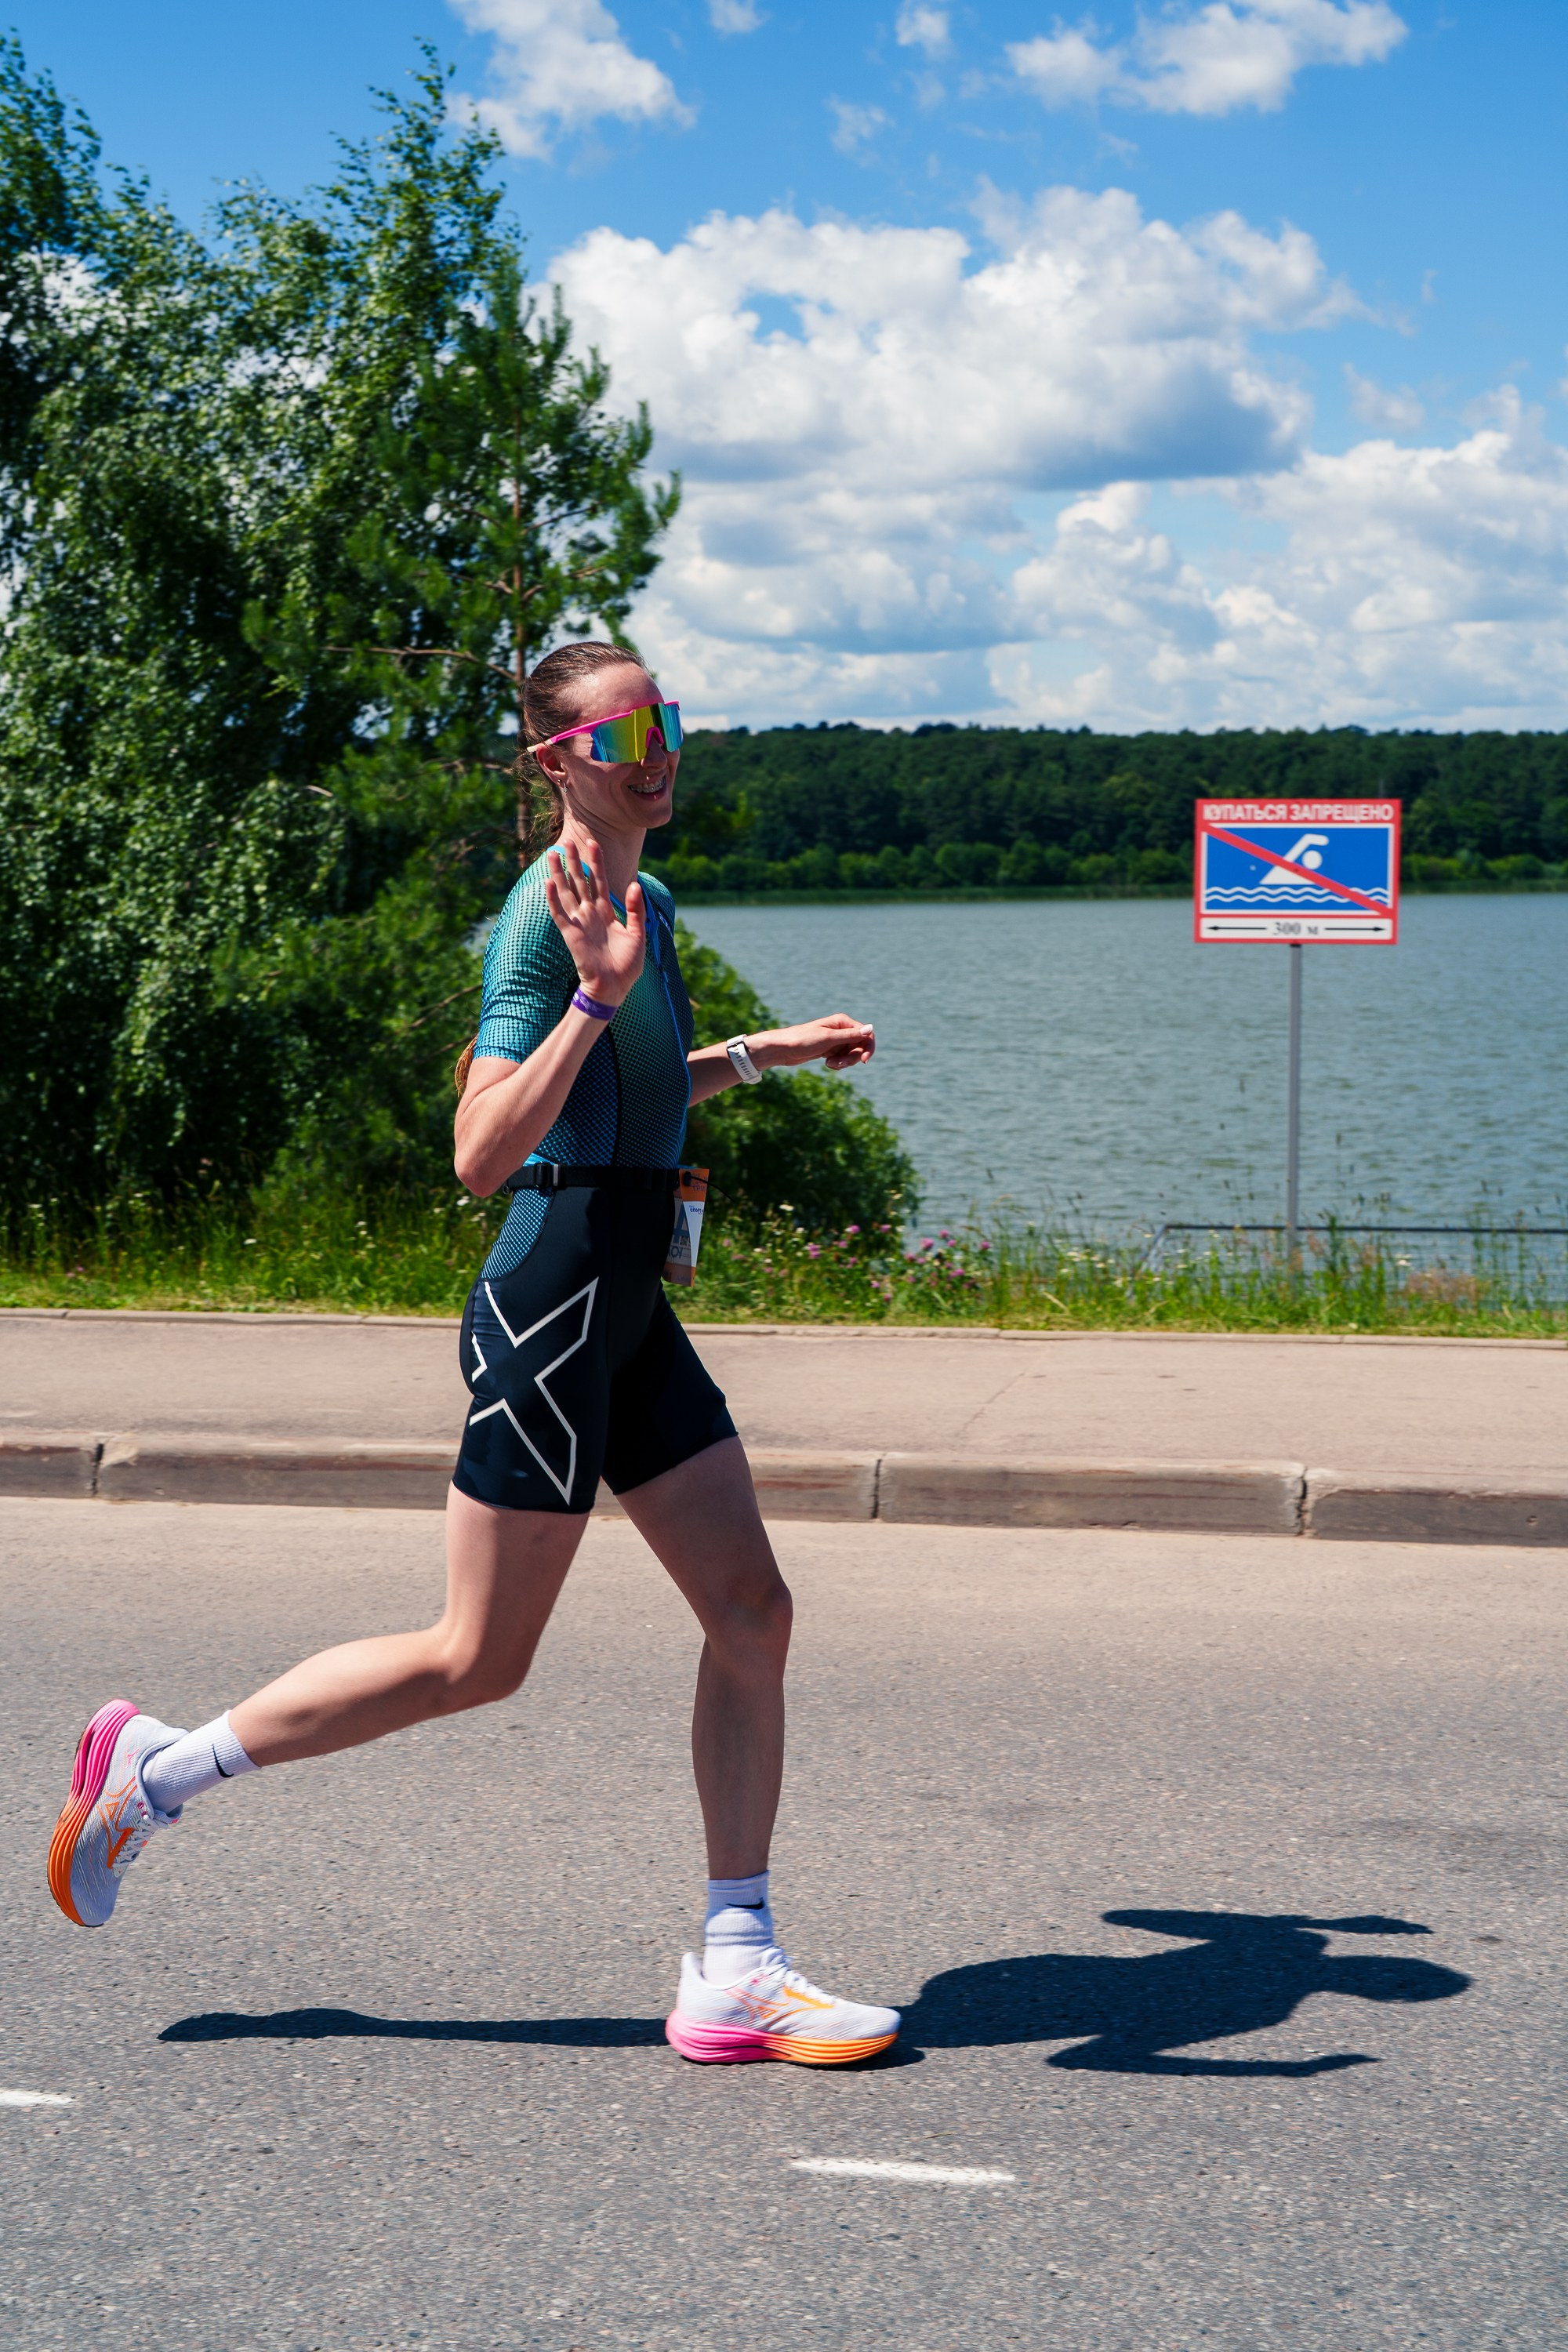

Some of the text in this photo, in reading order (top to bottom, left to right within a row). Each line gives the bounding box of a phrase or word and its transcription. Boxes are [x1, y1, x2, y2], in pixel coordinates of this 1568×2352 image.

[1203, 804, 1394, 822] КУПАТЬСЯ ЗАПРЕЩЕНО
[1272, 921, 1301, 935] 300
